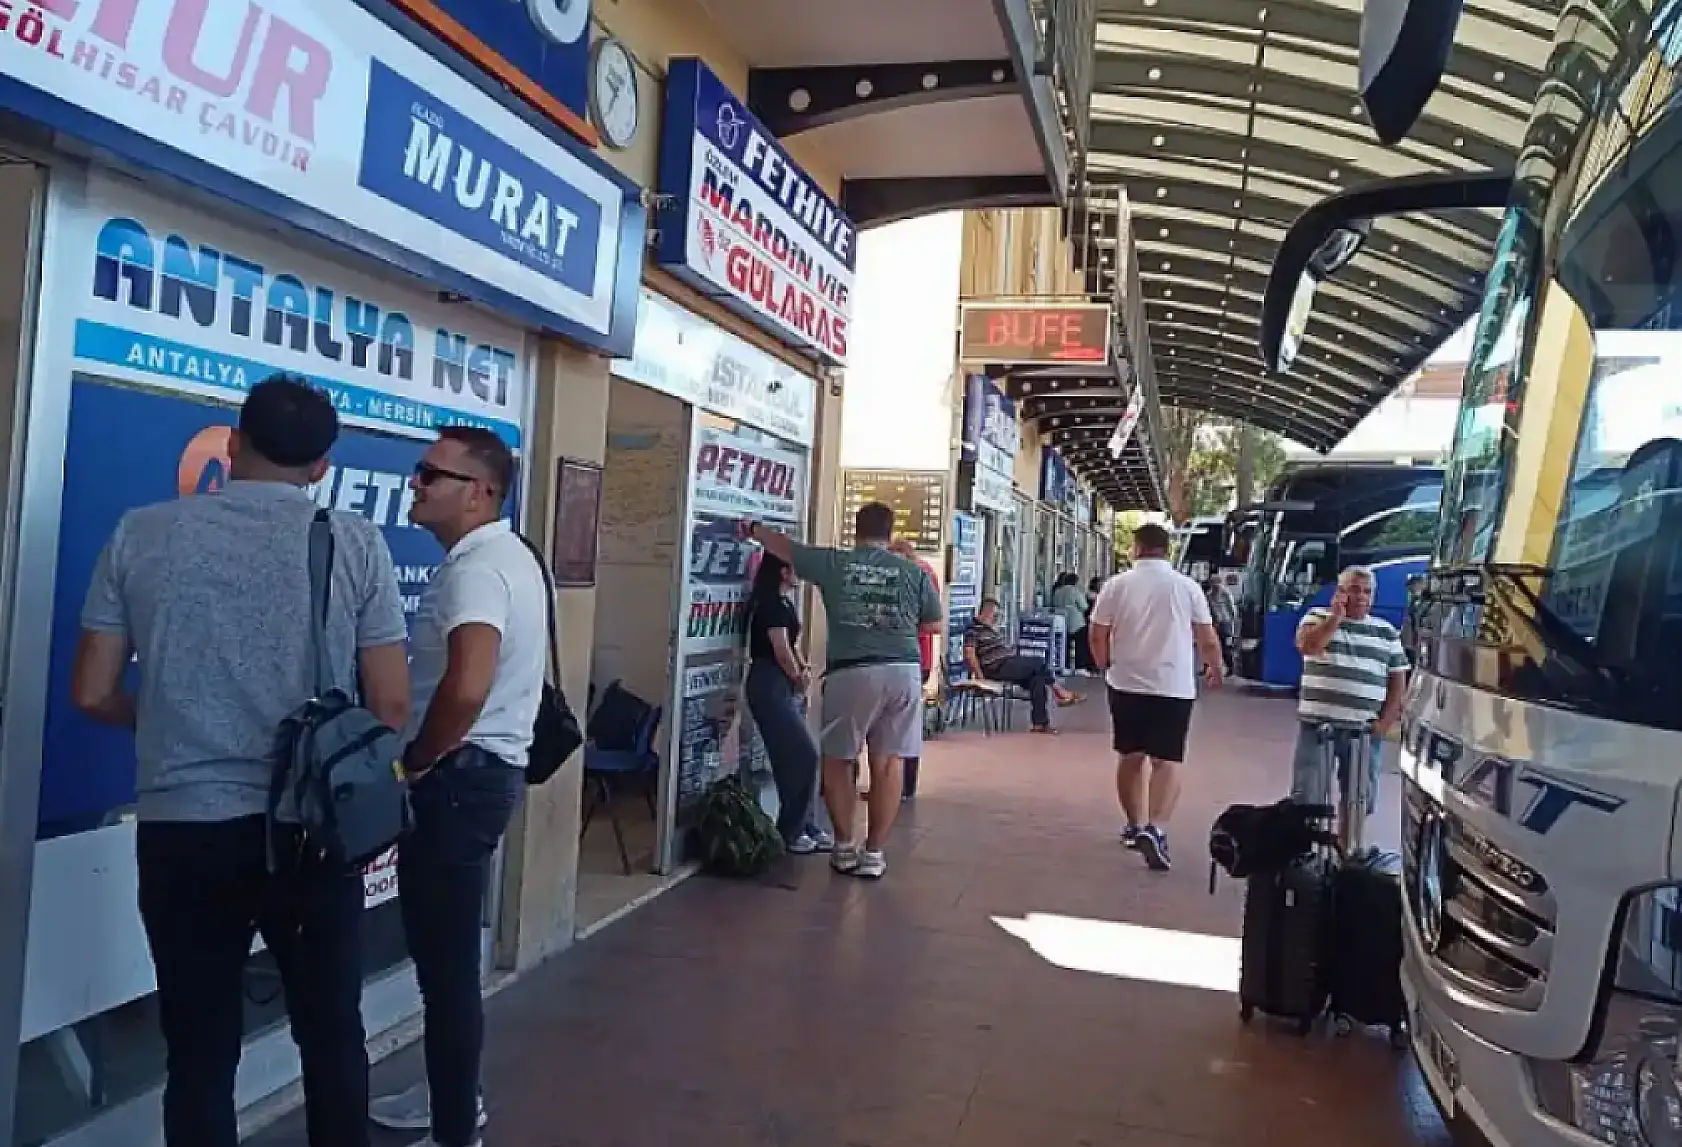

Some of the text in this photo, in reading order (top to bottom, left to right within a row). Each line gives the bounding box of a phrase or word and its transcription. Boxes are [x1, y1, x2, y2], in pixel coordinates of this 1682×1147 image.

[198, 101, 311, 173] ÇAVDIR
[403, 117, 579, 257] MURAT
[698, 165, 814, 282] MARDİN
[93, 216, 415, 381] ANTALYA
[125, 341, 436, 429] ANTALYA MERSİN
[696, 444, 796, 501] PETROL
